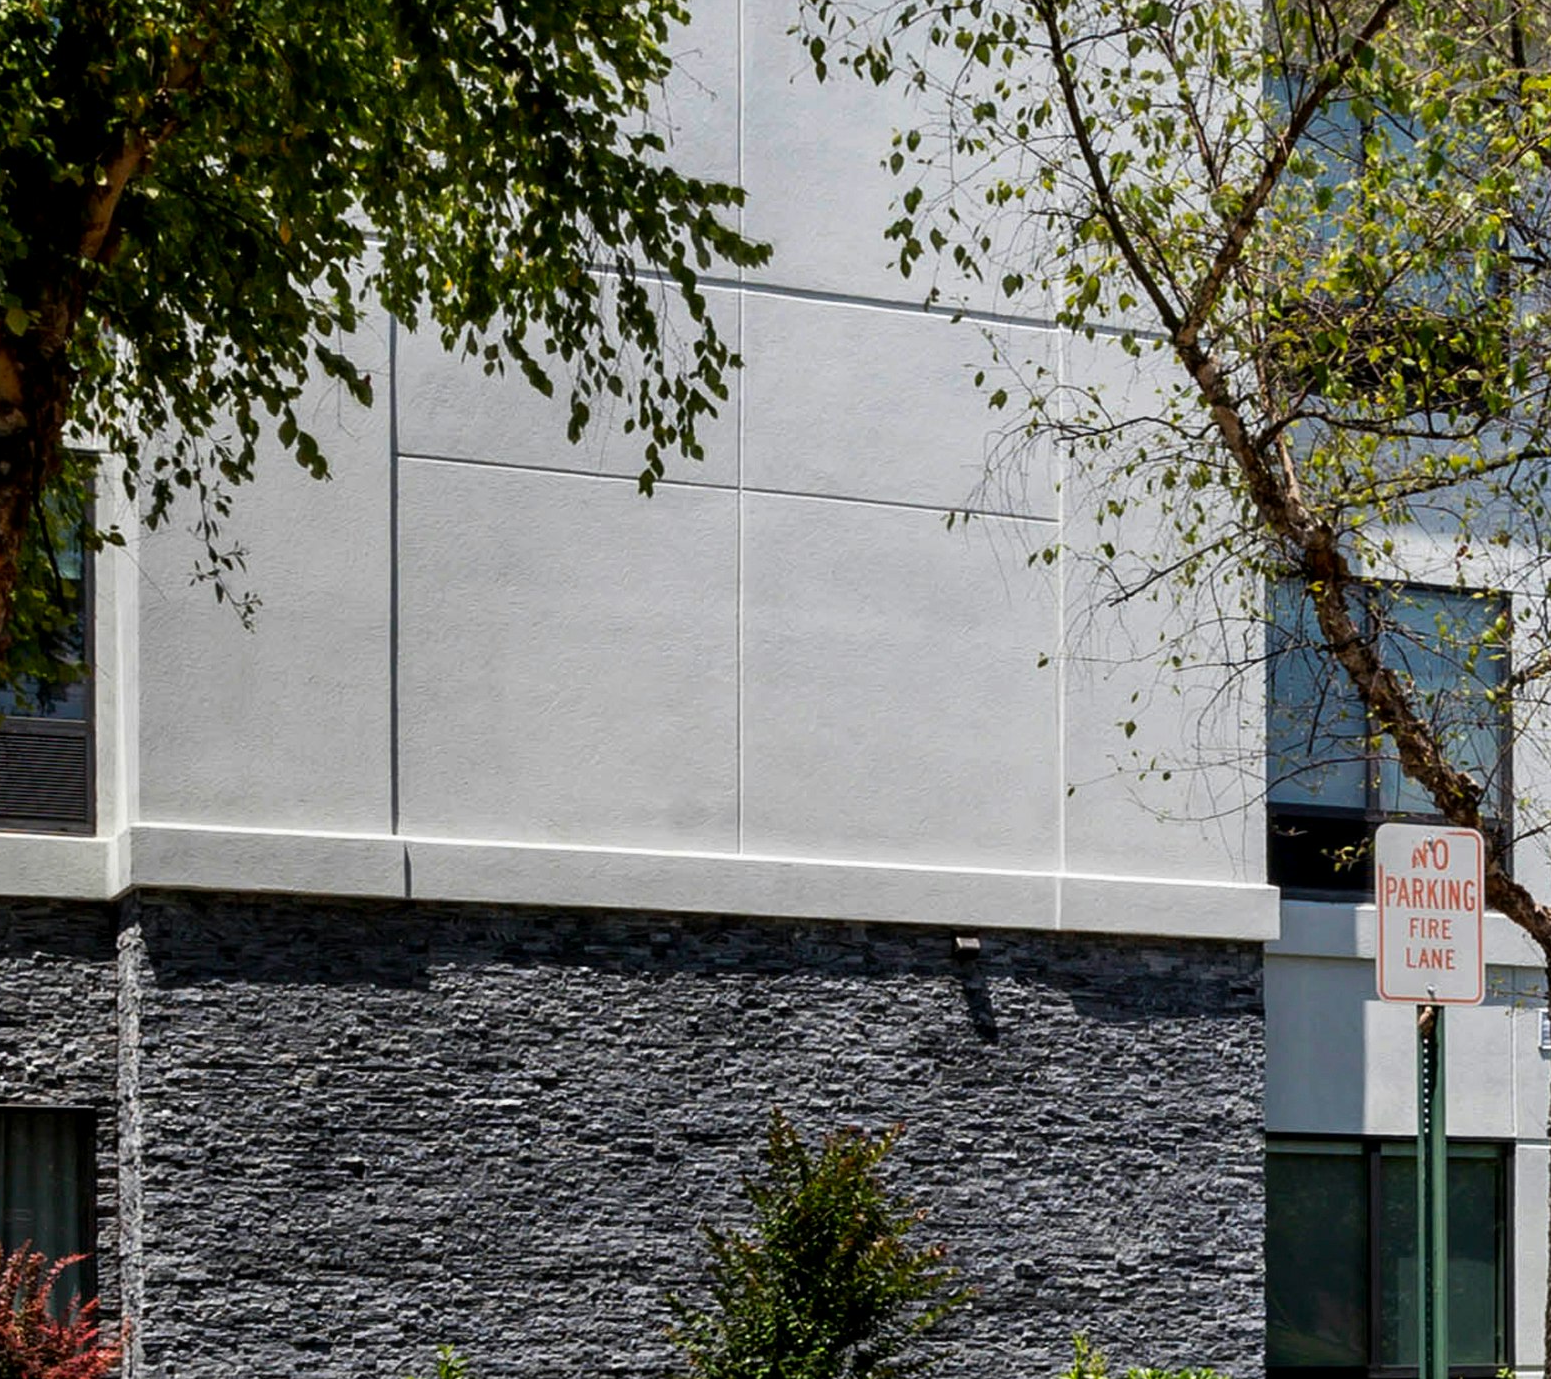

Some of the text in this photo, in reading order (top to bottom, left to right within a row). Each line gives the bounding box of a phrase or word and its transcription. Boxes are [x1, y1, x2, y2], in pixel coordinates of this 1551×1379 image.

[1411, 838, 1450, 871] NO
[1385, 876, 1476, 911] PARKING
[1409, 917, 1453, 940] FIRE
[1405, 948, 1456, 970] LANE
